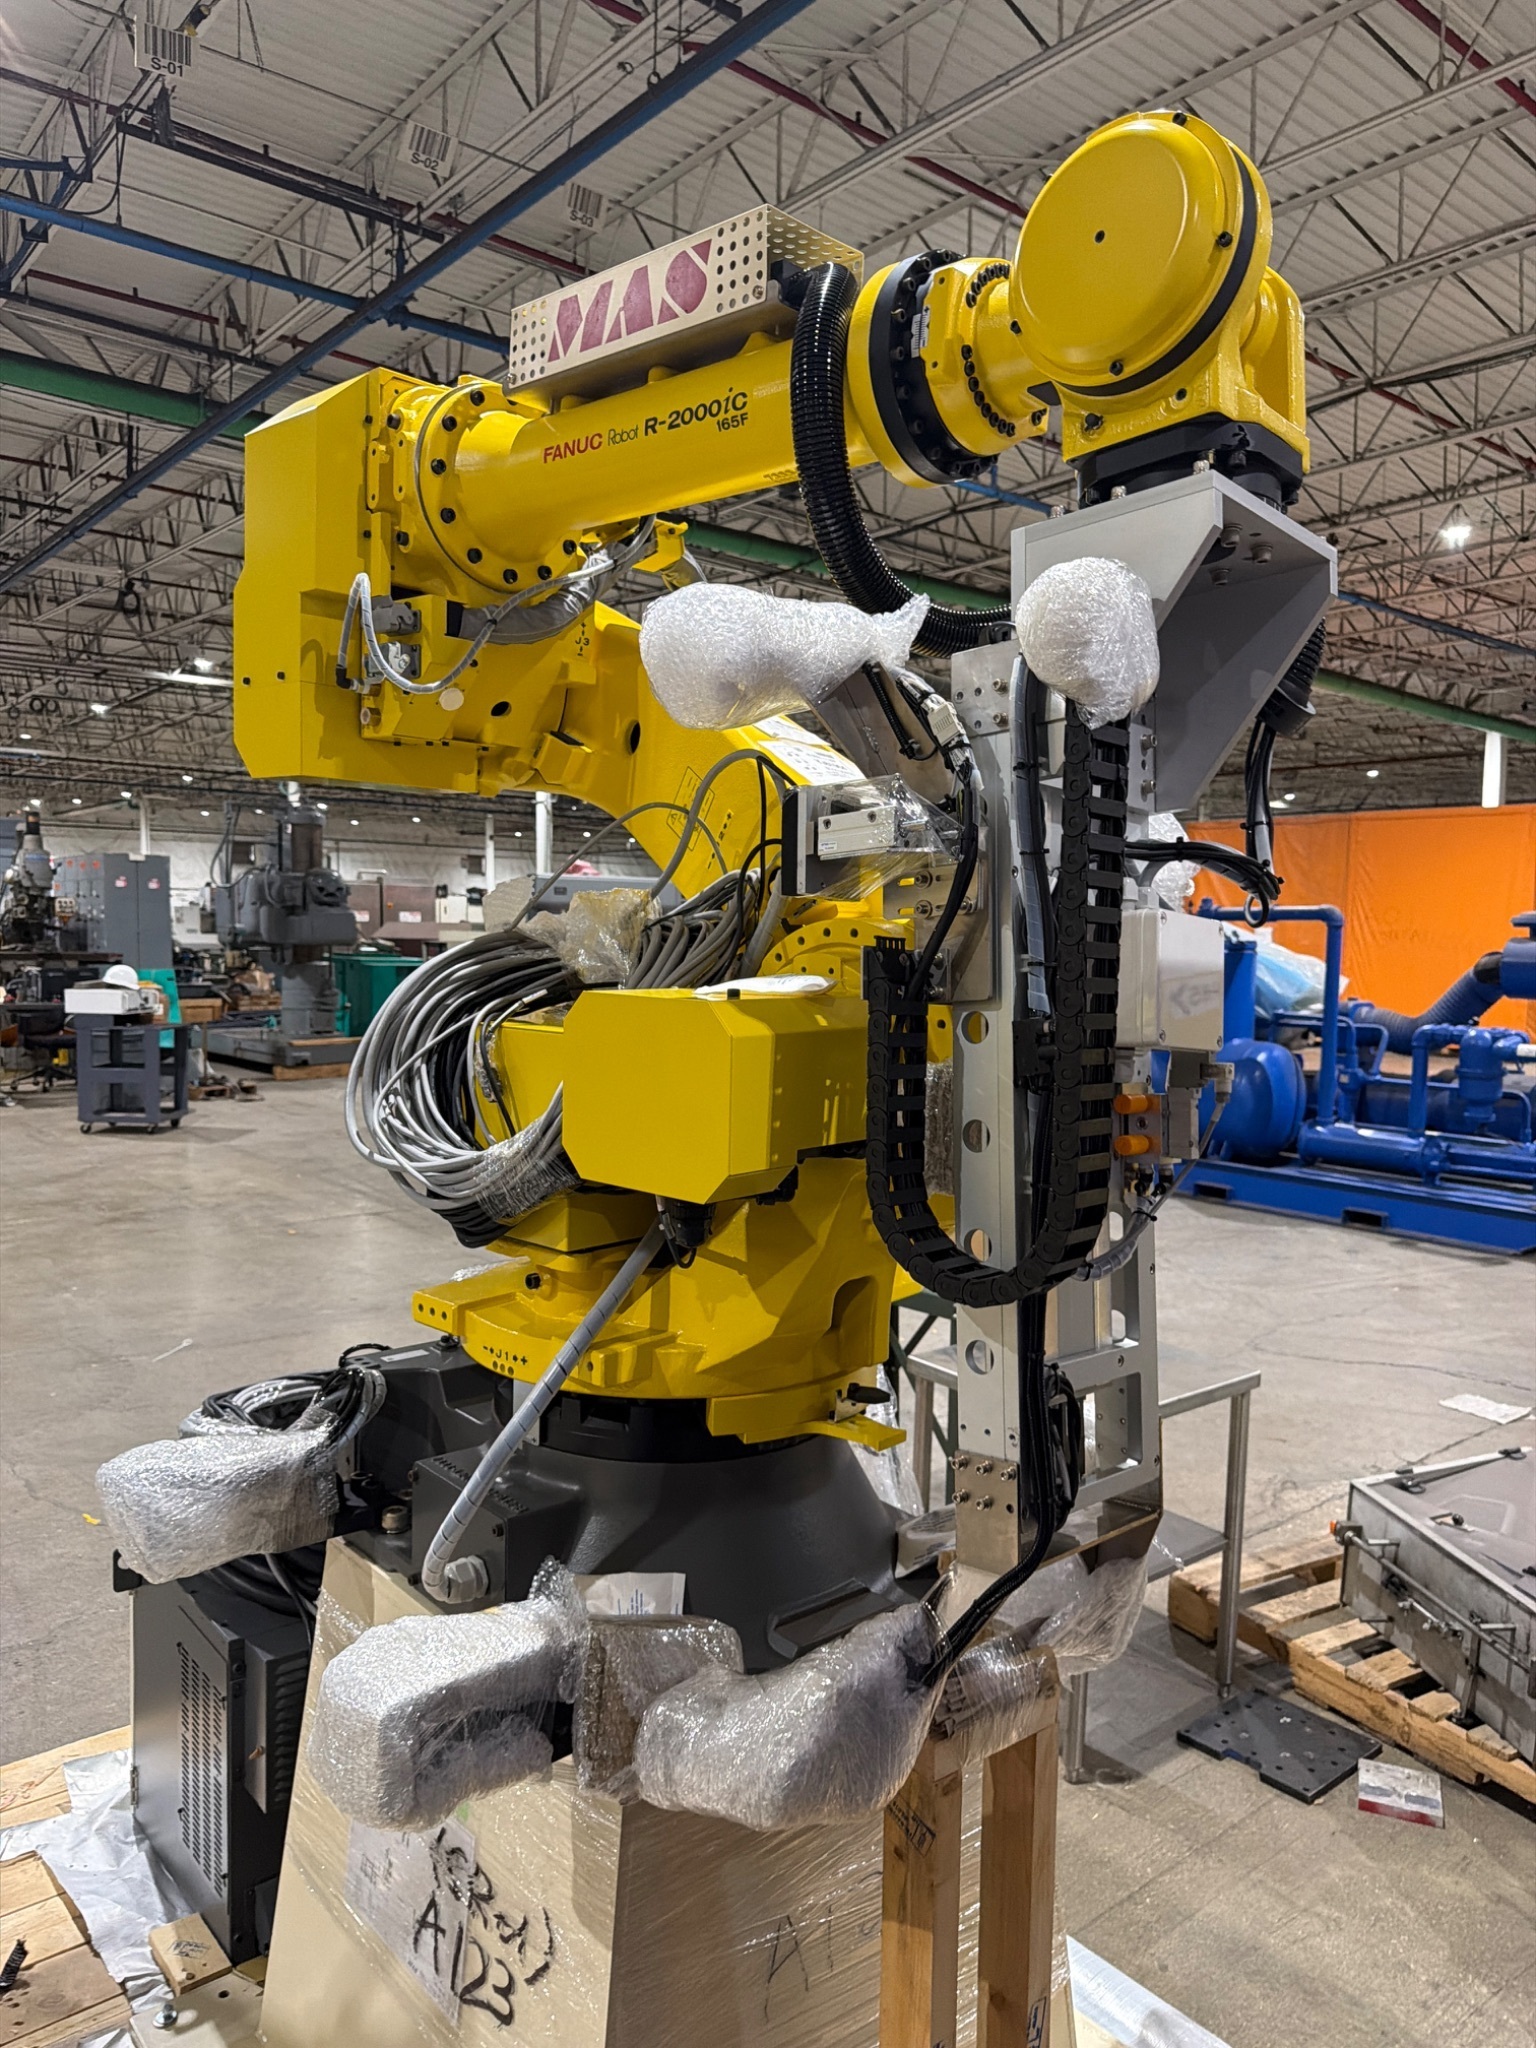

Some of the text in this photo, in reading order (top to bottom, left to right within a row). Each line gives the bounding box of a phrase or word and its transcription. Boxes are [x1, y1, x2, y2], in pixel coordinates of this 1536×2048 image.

[151, 57, 183, 77] S-01
[411, 152, 439, 171] S-02
[570, 209, 594, 228] S-03
[543, 433, 603, 464] FANUC
[607, 425, 639, 447] Robot
[644, 387, 748, 436] R-2000iC
[716, 412, 749, 432] 165F
[495, 1349, 509, 1361] J1
